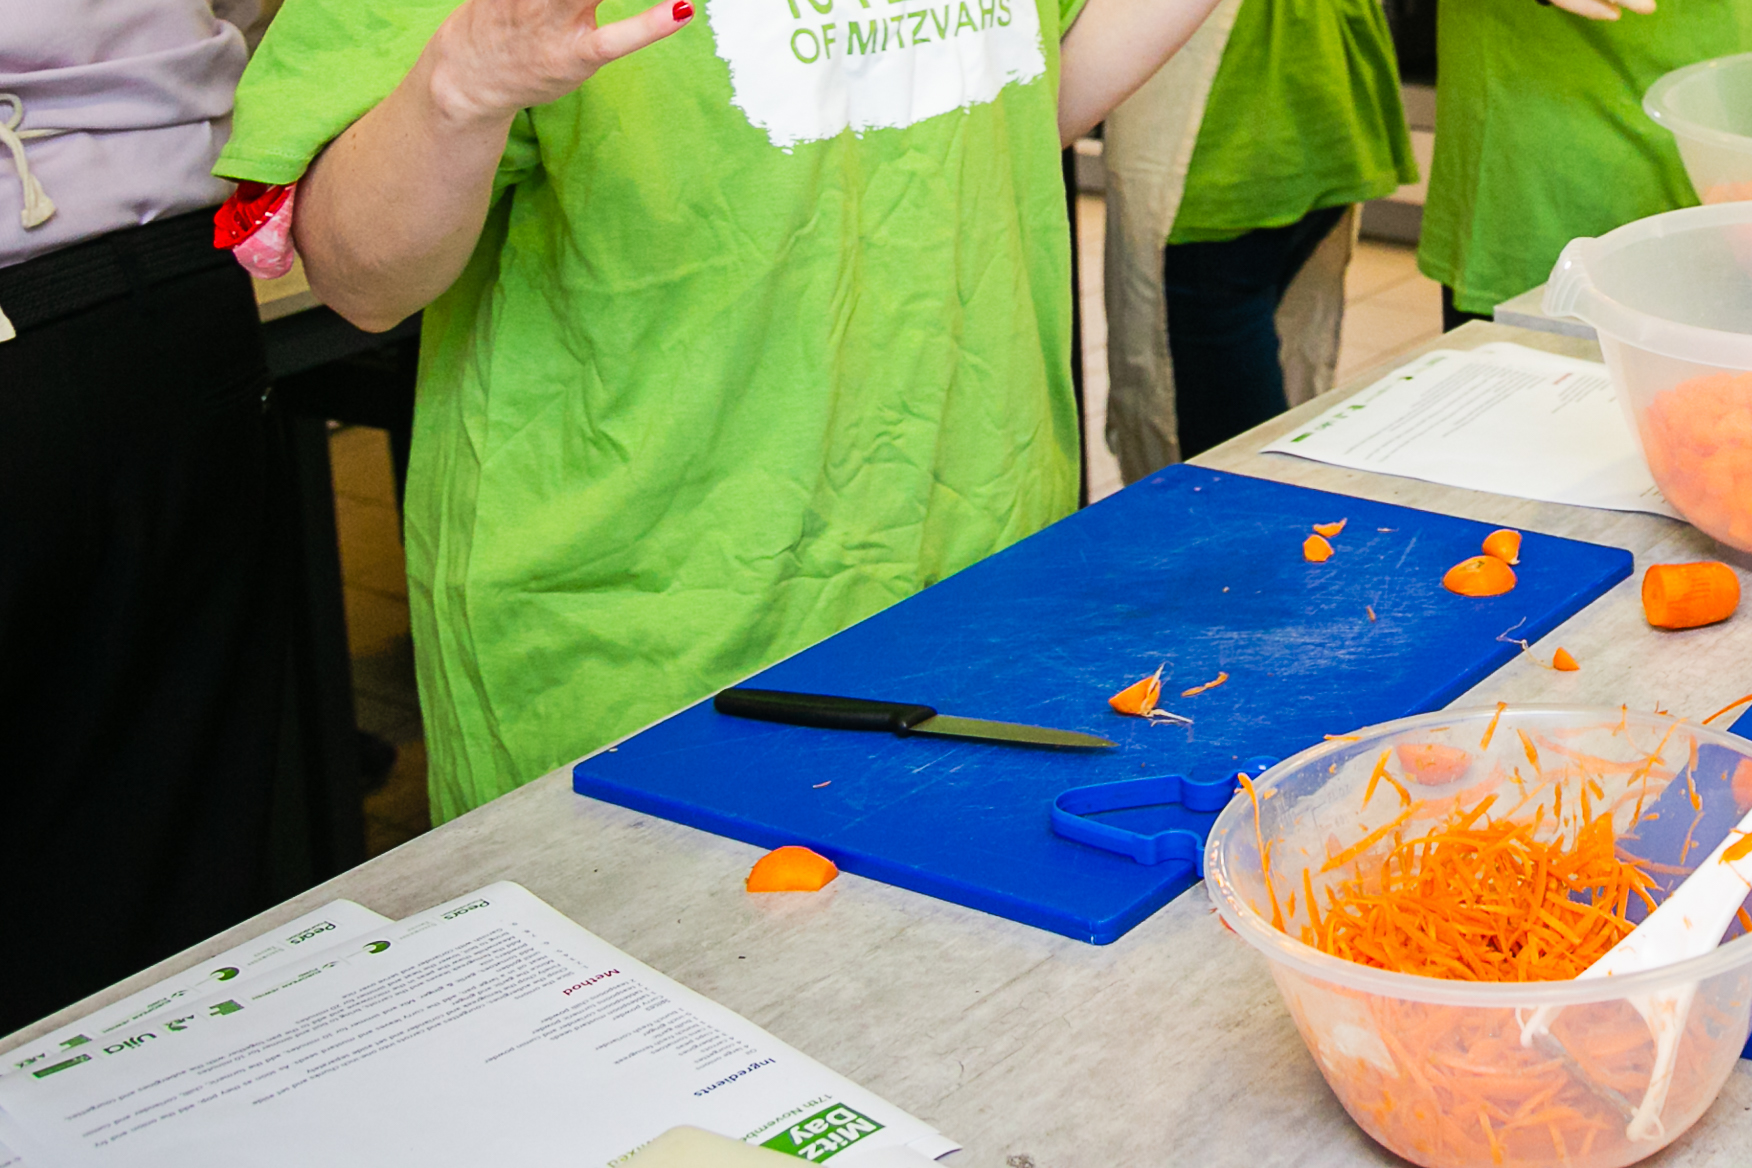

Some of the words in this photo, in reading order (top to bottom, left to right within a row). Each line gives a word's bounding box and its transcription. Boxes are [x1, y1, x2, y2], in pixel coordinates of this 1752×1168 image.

[789, 22, 838, 64] OF
[443, 899, 490, 920] Pears
[289, 922, 336, 944] Pears
[562, 968, 620, 996] Method
[102, 1032, 156, 1054] ujia
[693, 1057, 775, 1096] Ingredients
[787, 1105, 856, 1146] Day
